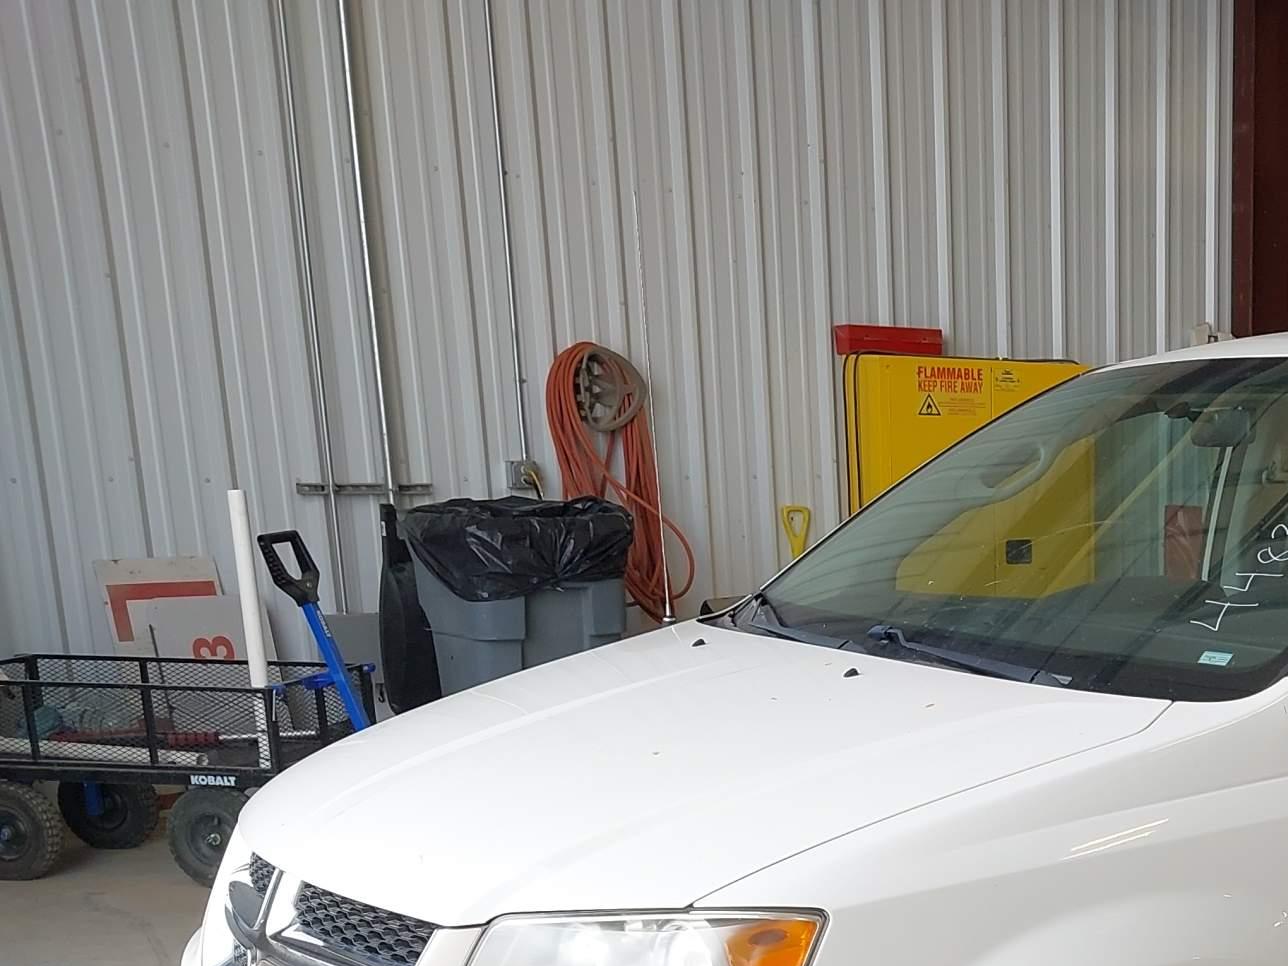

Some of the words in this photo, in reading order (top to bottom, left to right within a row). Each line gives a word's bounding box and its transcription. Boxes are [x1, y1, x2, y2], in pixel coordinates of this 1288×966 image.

[917, 366, 984, 381] FLAMMABLE
[918, 380, 938, 392] KEEP
[940, 381, 958, 393] FIRE
[960, 382, 984, 394] AWAY
[190, 774, 237, 787] KOBALT
